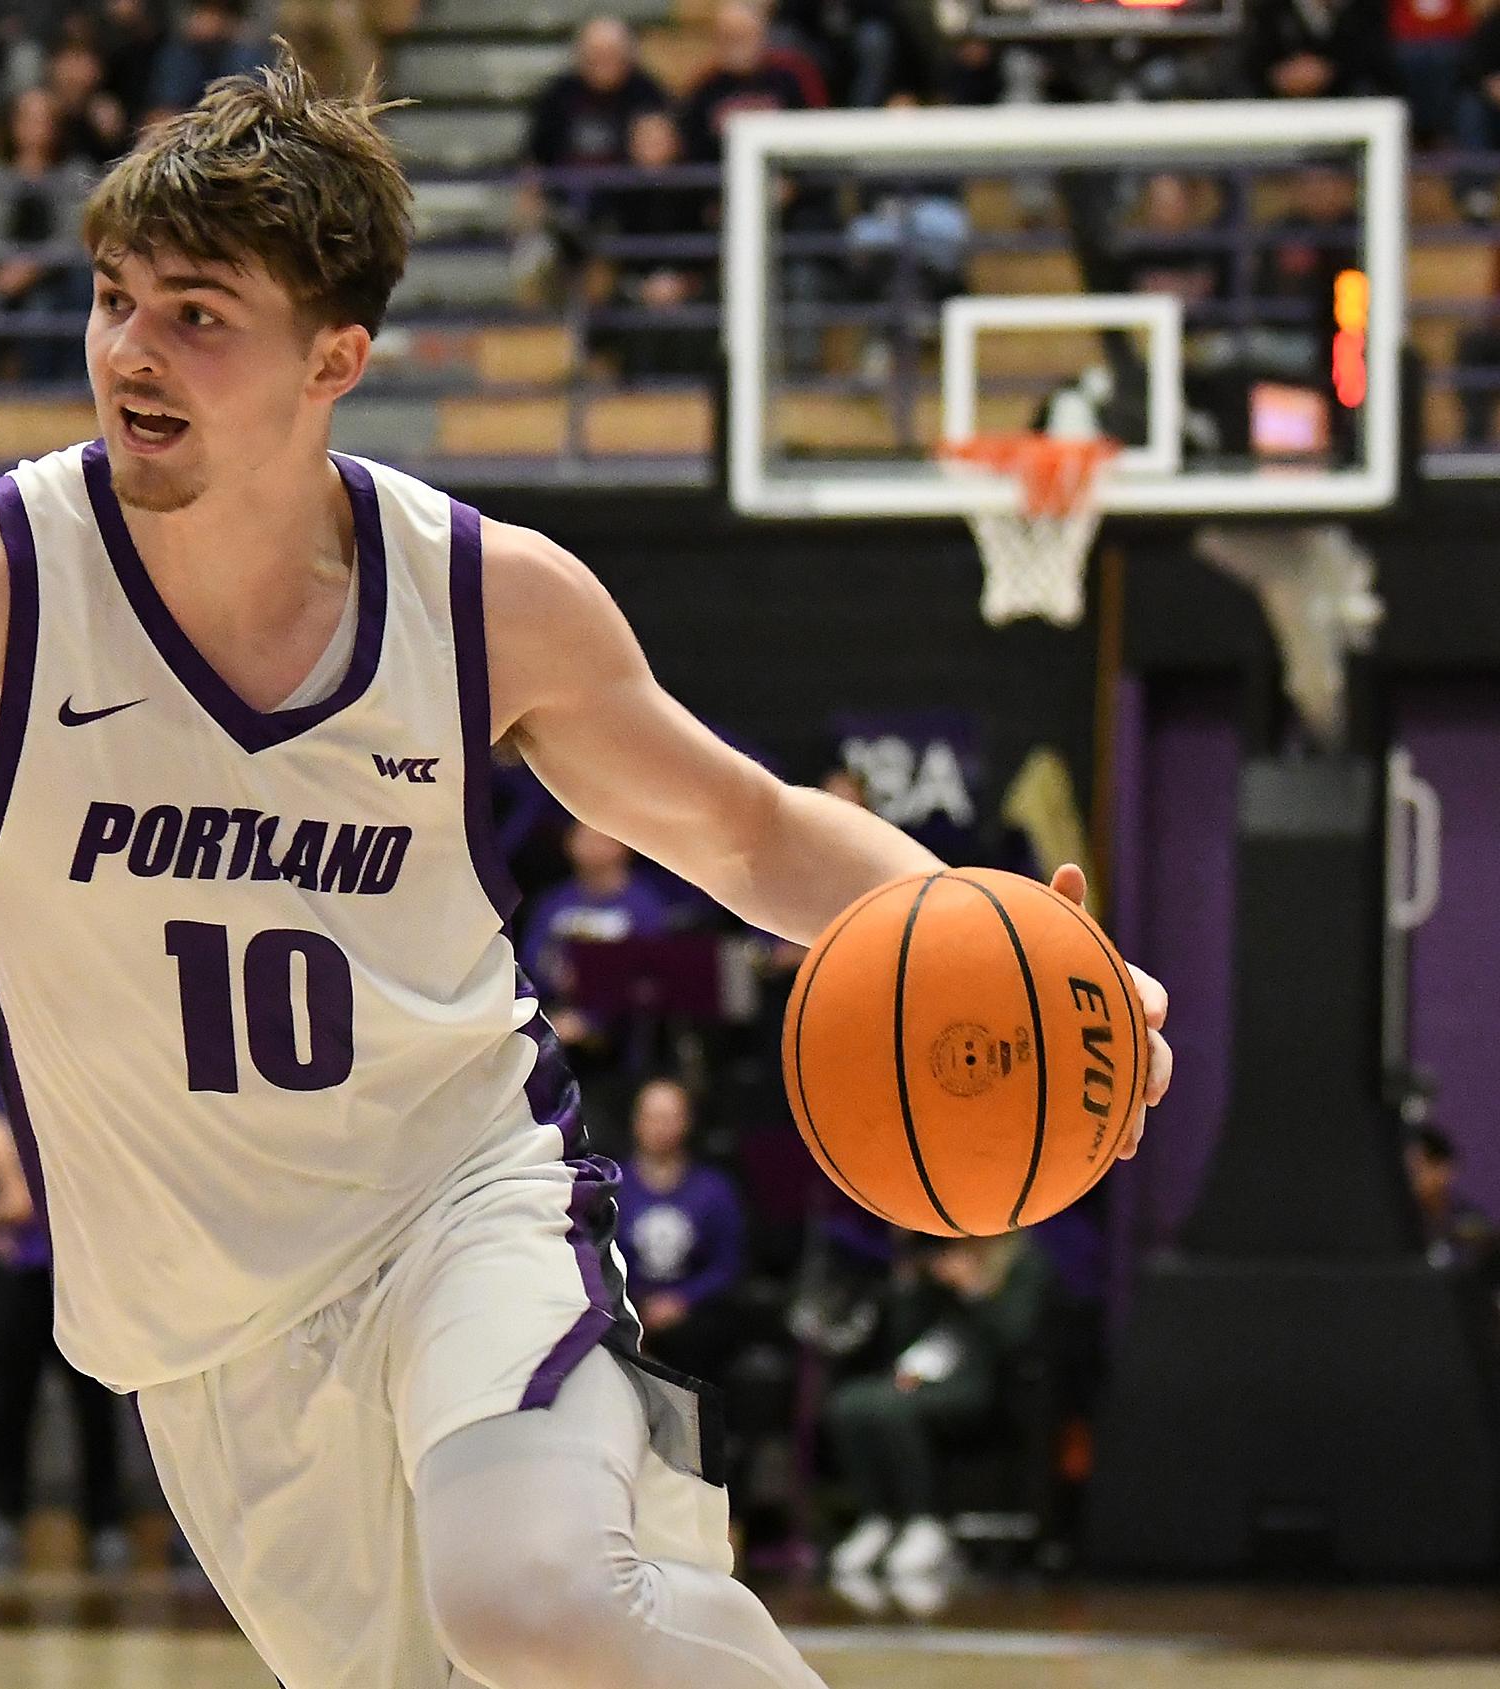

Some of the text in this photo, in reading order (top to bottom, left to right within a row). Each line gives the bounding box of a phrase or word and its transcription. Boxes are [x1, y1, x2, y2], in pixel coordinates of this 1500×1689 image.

[371, 752, 440, 784] WCC
[68, 800, 413, 895] PORTLAND
[163, 919, 355, 1094] 10
[1068, 976, 1115, 1118] EVO
